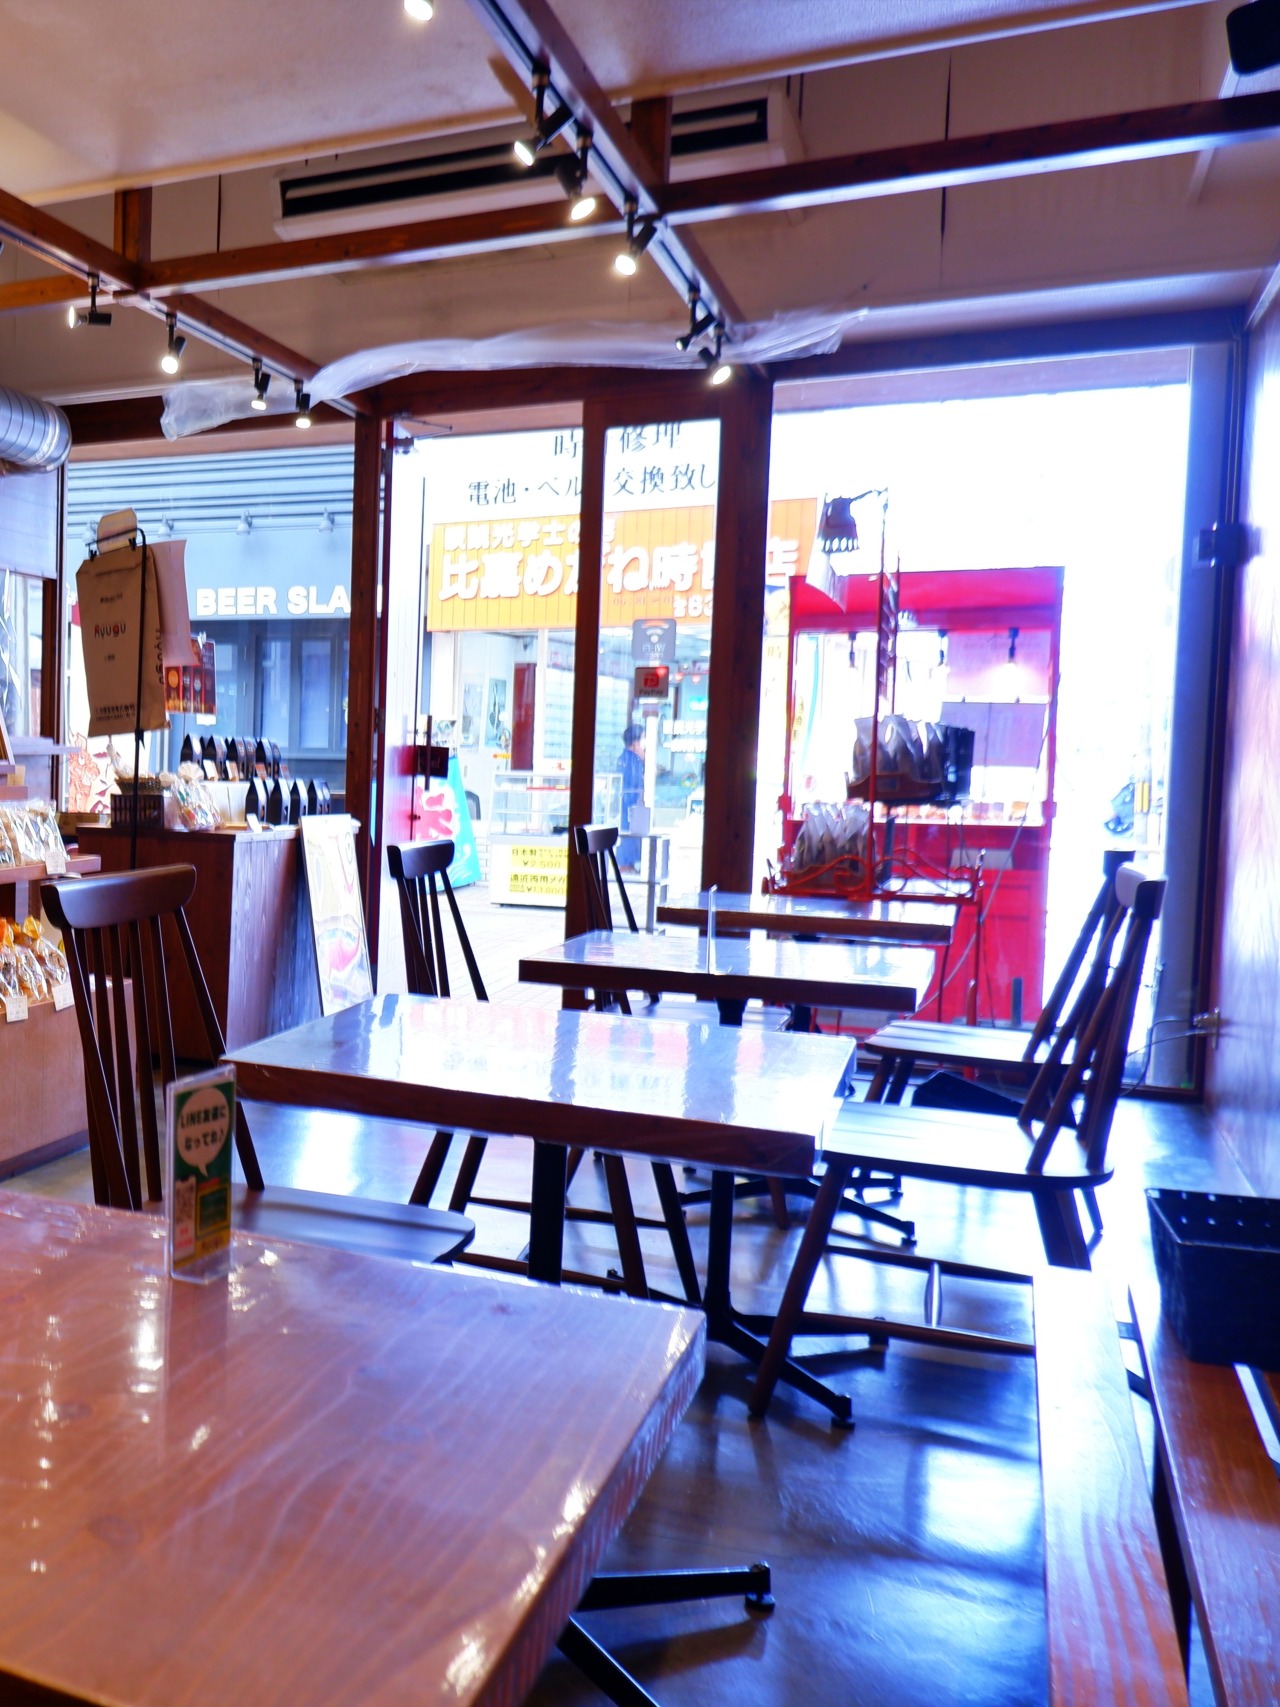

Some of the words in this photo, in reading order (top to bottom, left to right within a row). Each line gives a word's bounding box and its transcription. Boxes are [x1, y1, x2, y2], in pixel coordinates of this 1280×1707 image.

[468, 463, 716, 507] 電池・ベル交換致し
[197, 586, 278, 617] BEER
[287, 585, 382, 616] SLA
